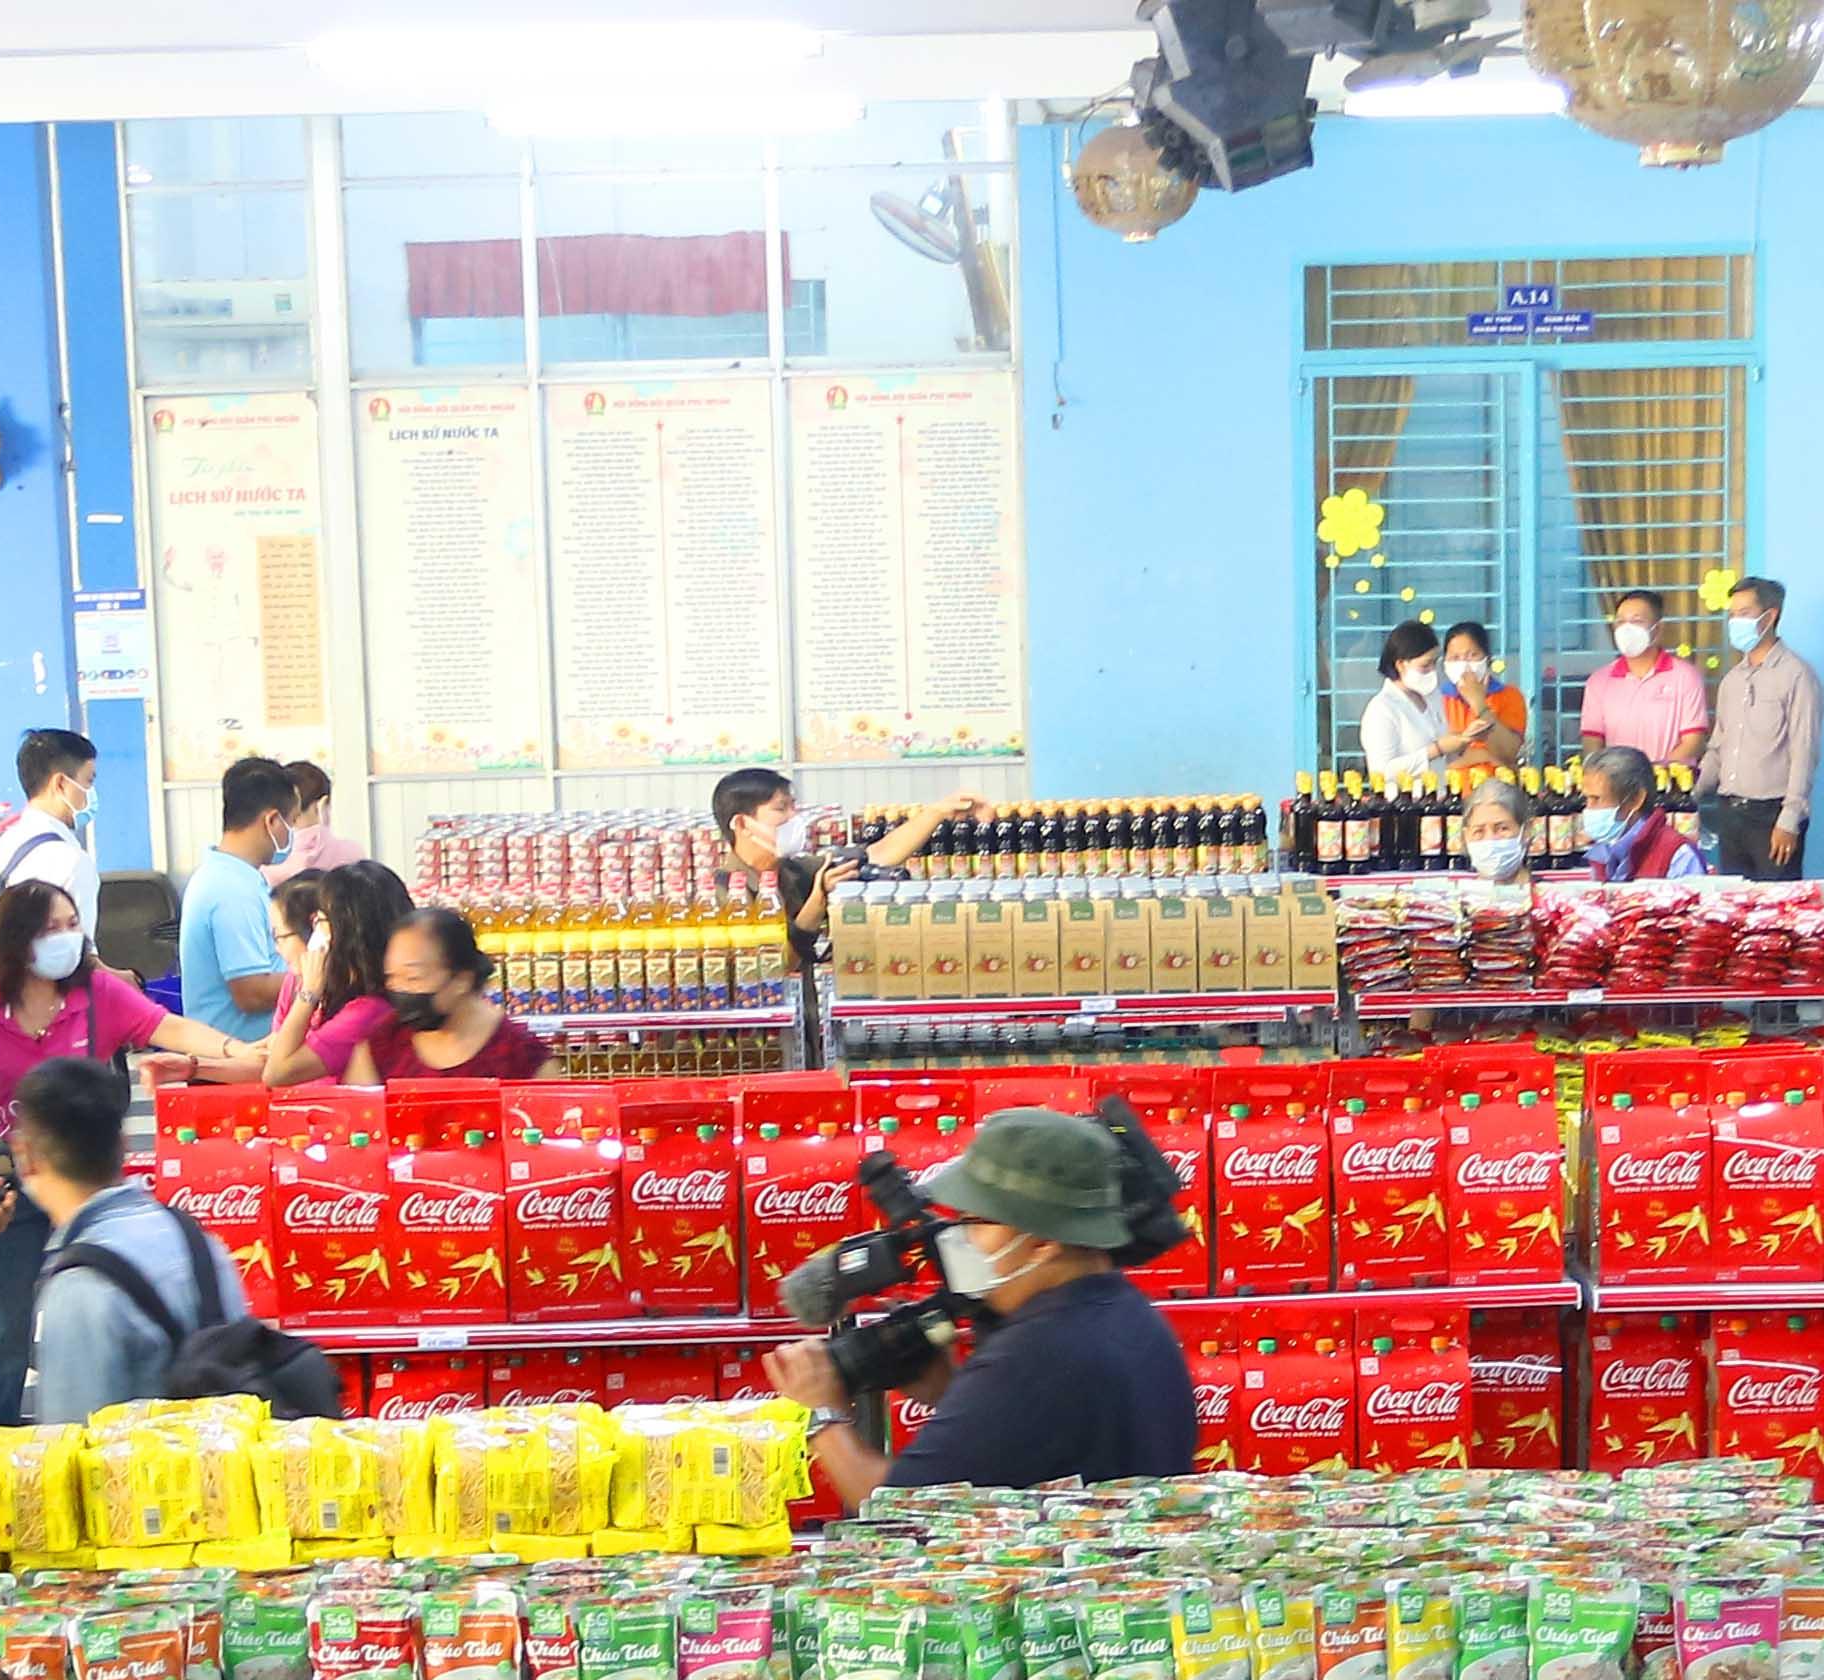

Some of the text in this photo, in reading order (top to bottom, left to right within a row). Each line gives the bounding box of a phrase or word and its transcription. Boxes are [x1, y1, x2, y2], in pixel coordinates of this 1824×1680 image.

[1510, 289, 1549, 305] A.14
[1224, 1143, 1323, 1179] Coca-Cola
[1342, 1135, 1441, 1175] Coca-Cola
[1456, 1151, 1554, 1186] Coca-Cola
[1607, 1148, 1705, 1188] Coca-Cola
[1723, 1147, 1820, 1185] Coca-Cola
[515, 1179, 614, 1224] Coca-Cola
[631, 1167, 731, 1207] Coca-Cola
[752, 1179, 853, 1219] Coca-Cola
[1600, 1357, 1693, 1392] Coca-Cola
[1251, 1396, 1349, 1432] Coca-Cola
[1366, 1380, 1465, 1416] Coca-Cola
